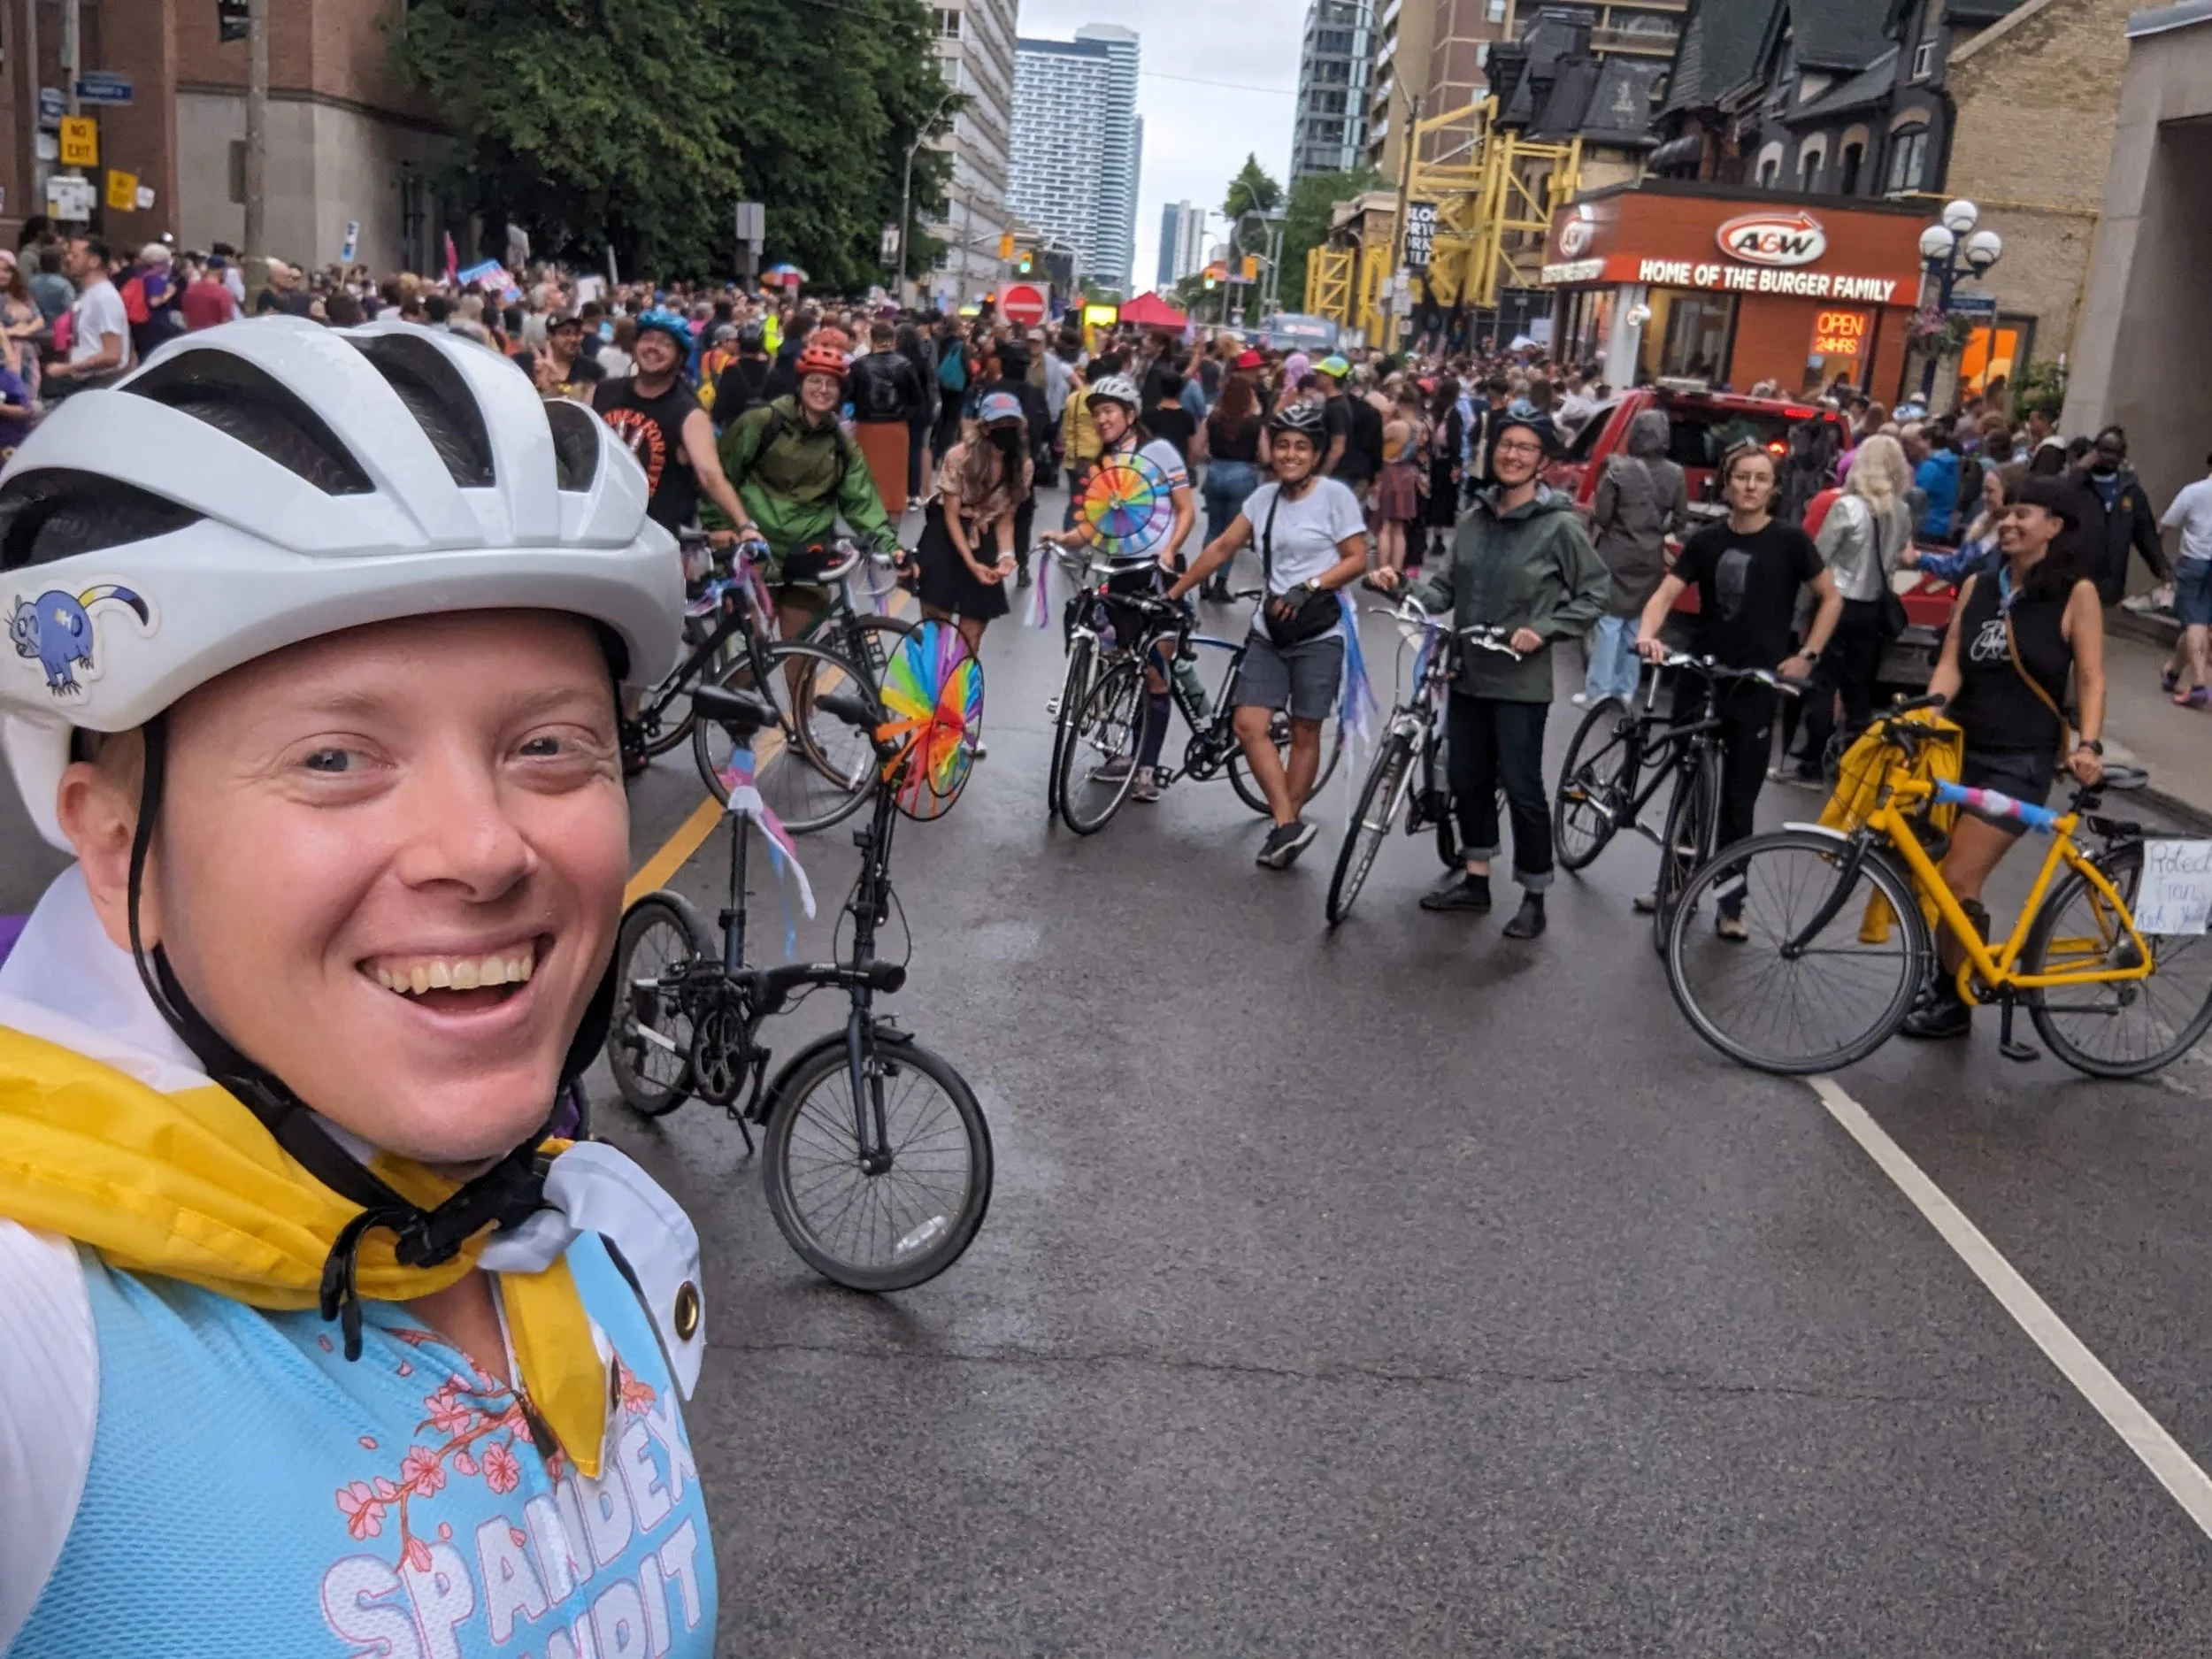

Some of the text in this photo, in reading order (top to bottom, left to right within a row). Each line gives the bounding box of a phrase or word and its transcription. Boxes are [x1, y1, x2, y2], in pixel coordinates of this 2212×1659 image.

[71, 123, 87, 137] NO
[67, 143, 90, 157] EXIT
[1736, 232, 1815, 256] A&W
[1639, 258, 1897, 303] HOME OF THE BURGER FAMILY
[1817, 312, 1864, 336] OPEN
[320, 1386, 699, 1659] SPANDEX
